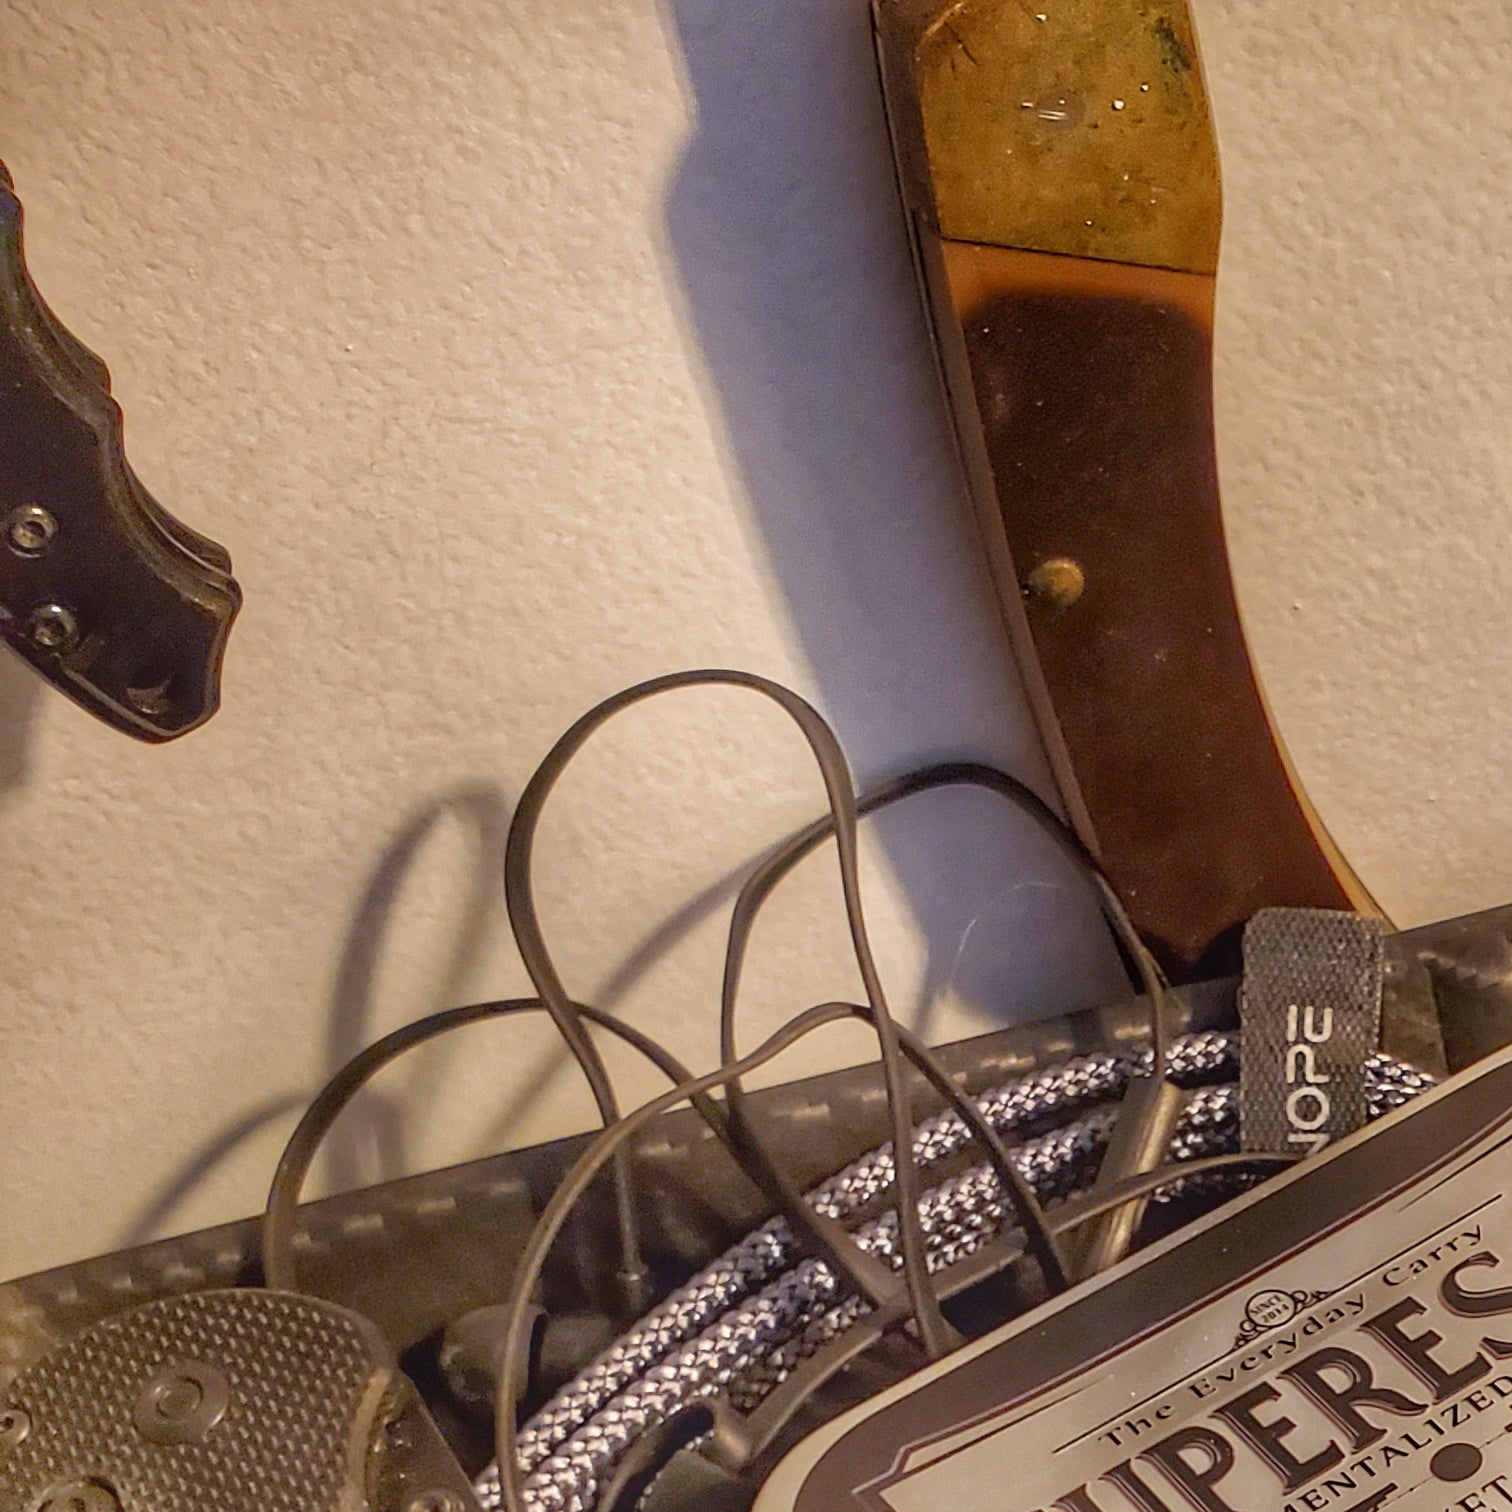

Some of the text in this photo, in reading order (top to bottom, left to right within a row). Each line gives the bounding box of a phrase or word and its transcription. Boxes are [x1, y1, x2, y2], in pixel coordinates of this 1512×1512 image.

[1098, 1224, 1482, 1447] The Everyday Carry
[1250, 1294, 1281, 1314] SINCE
